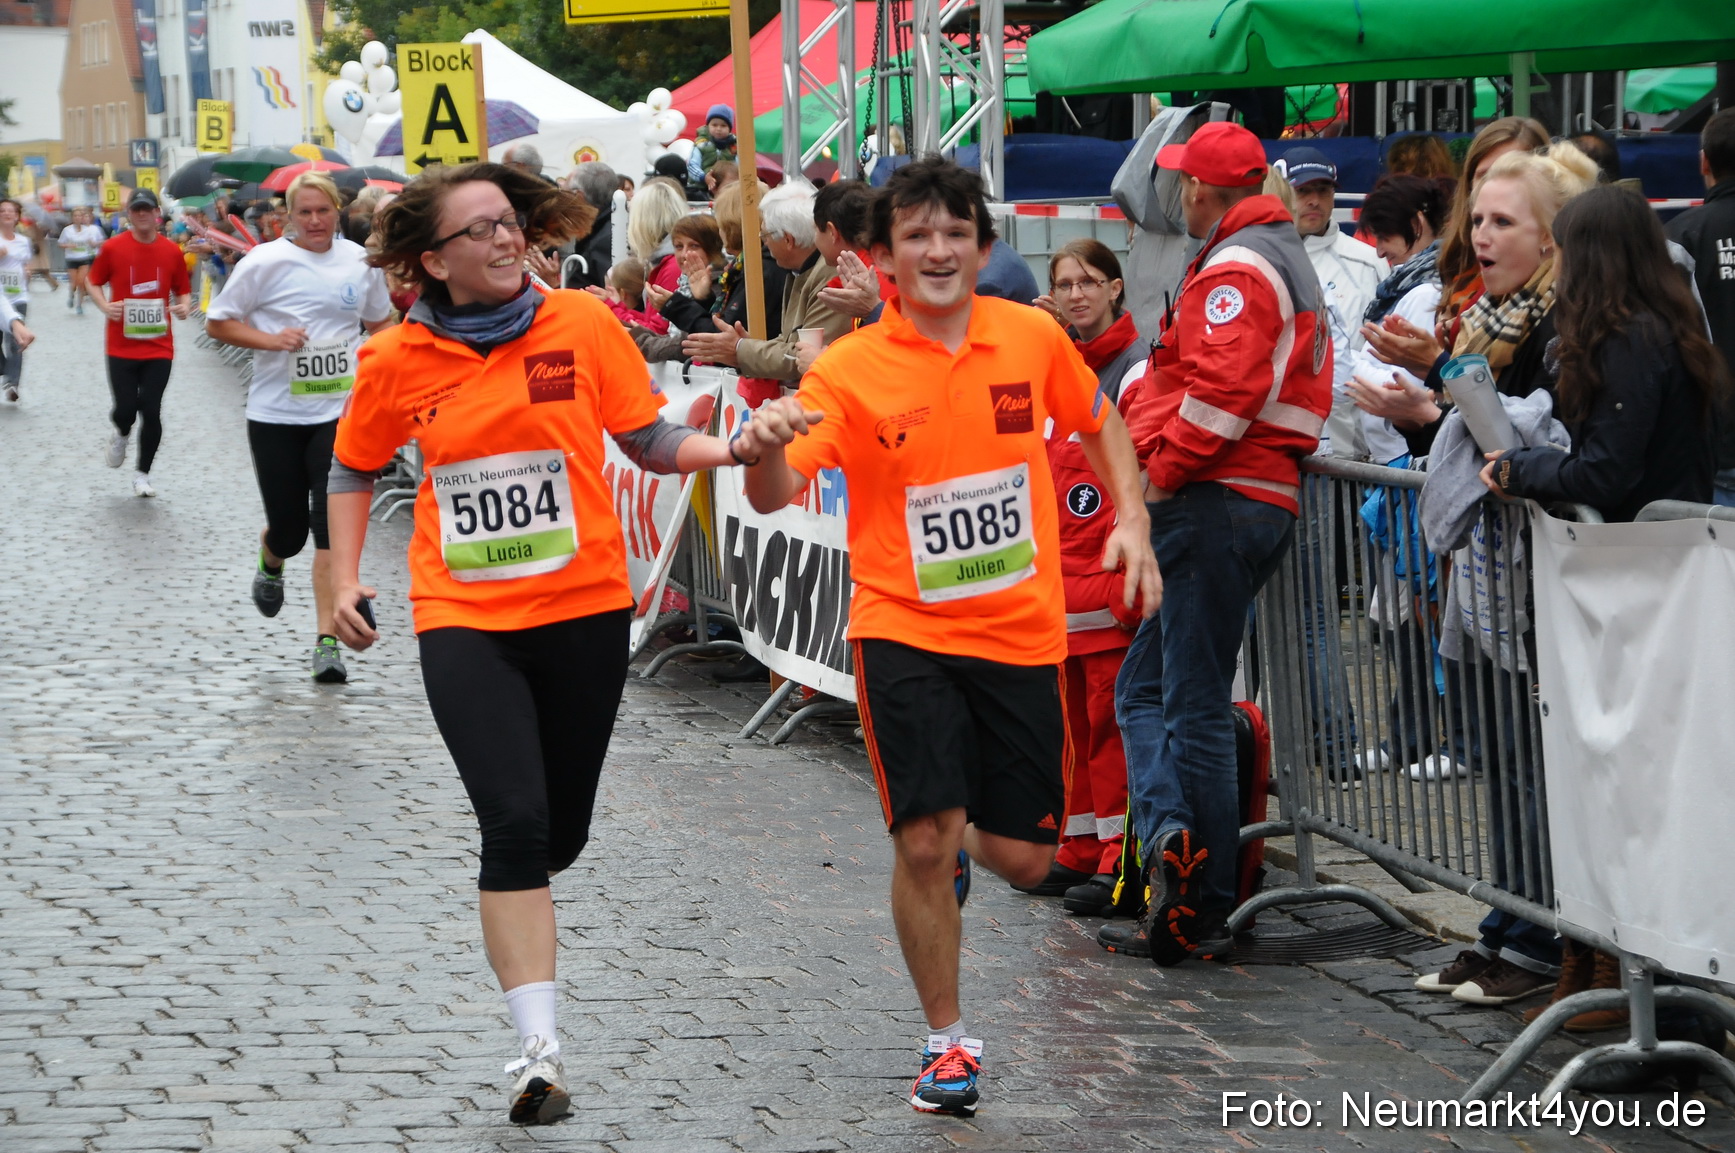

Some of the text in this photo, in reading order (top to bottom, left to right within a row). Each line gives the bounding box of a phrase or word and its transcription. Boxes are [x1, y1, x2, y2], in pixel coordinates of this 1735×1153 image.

[407, 48, 475, 74] Block
[200, 101, 229, 113] Block
[421, 82, 470, 146] A
[205, 115, 224, 142] B
[106, 189, 116, 202] D
[1209, 289, 1238, 305] DEUTSCHES
[295, 350, 348, 378] 5005
[526, 361, 575, 382] Meier
[305, 381, 342, 392] Susanne
[993, 394, 1033, 412] Meier
[435, 463, 542, 489] PARTL Neumarkt
[451, 479, 560, 536] 5084
[907, 481, 1009, 510] PARTL Neumarkt
[921, 495, 1021, 555] 5085
[486, 540, 534, 563] Lucia
[956, 556, 1006, 582] Julien
